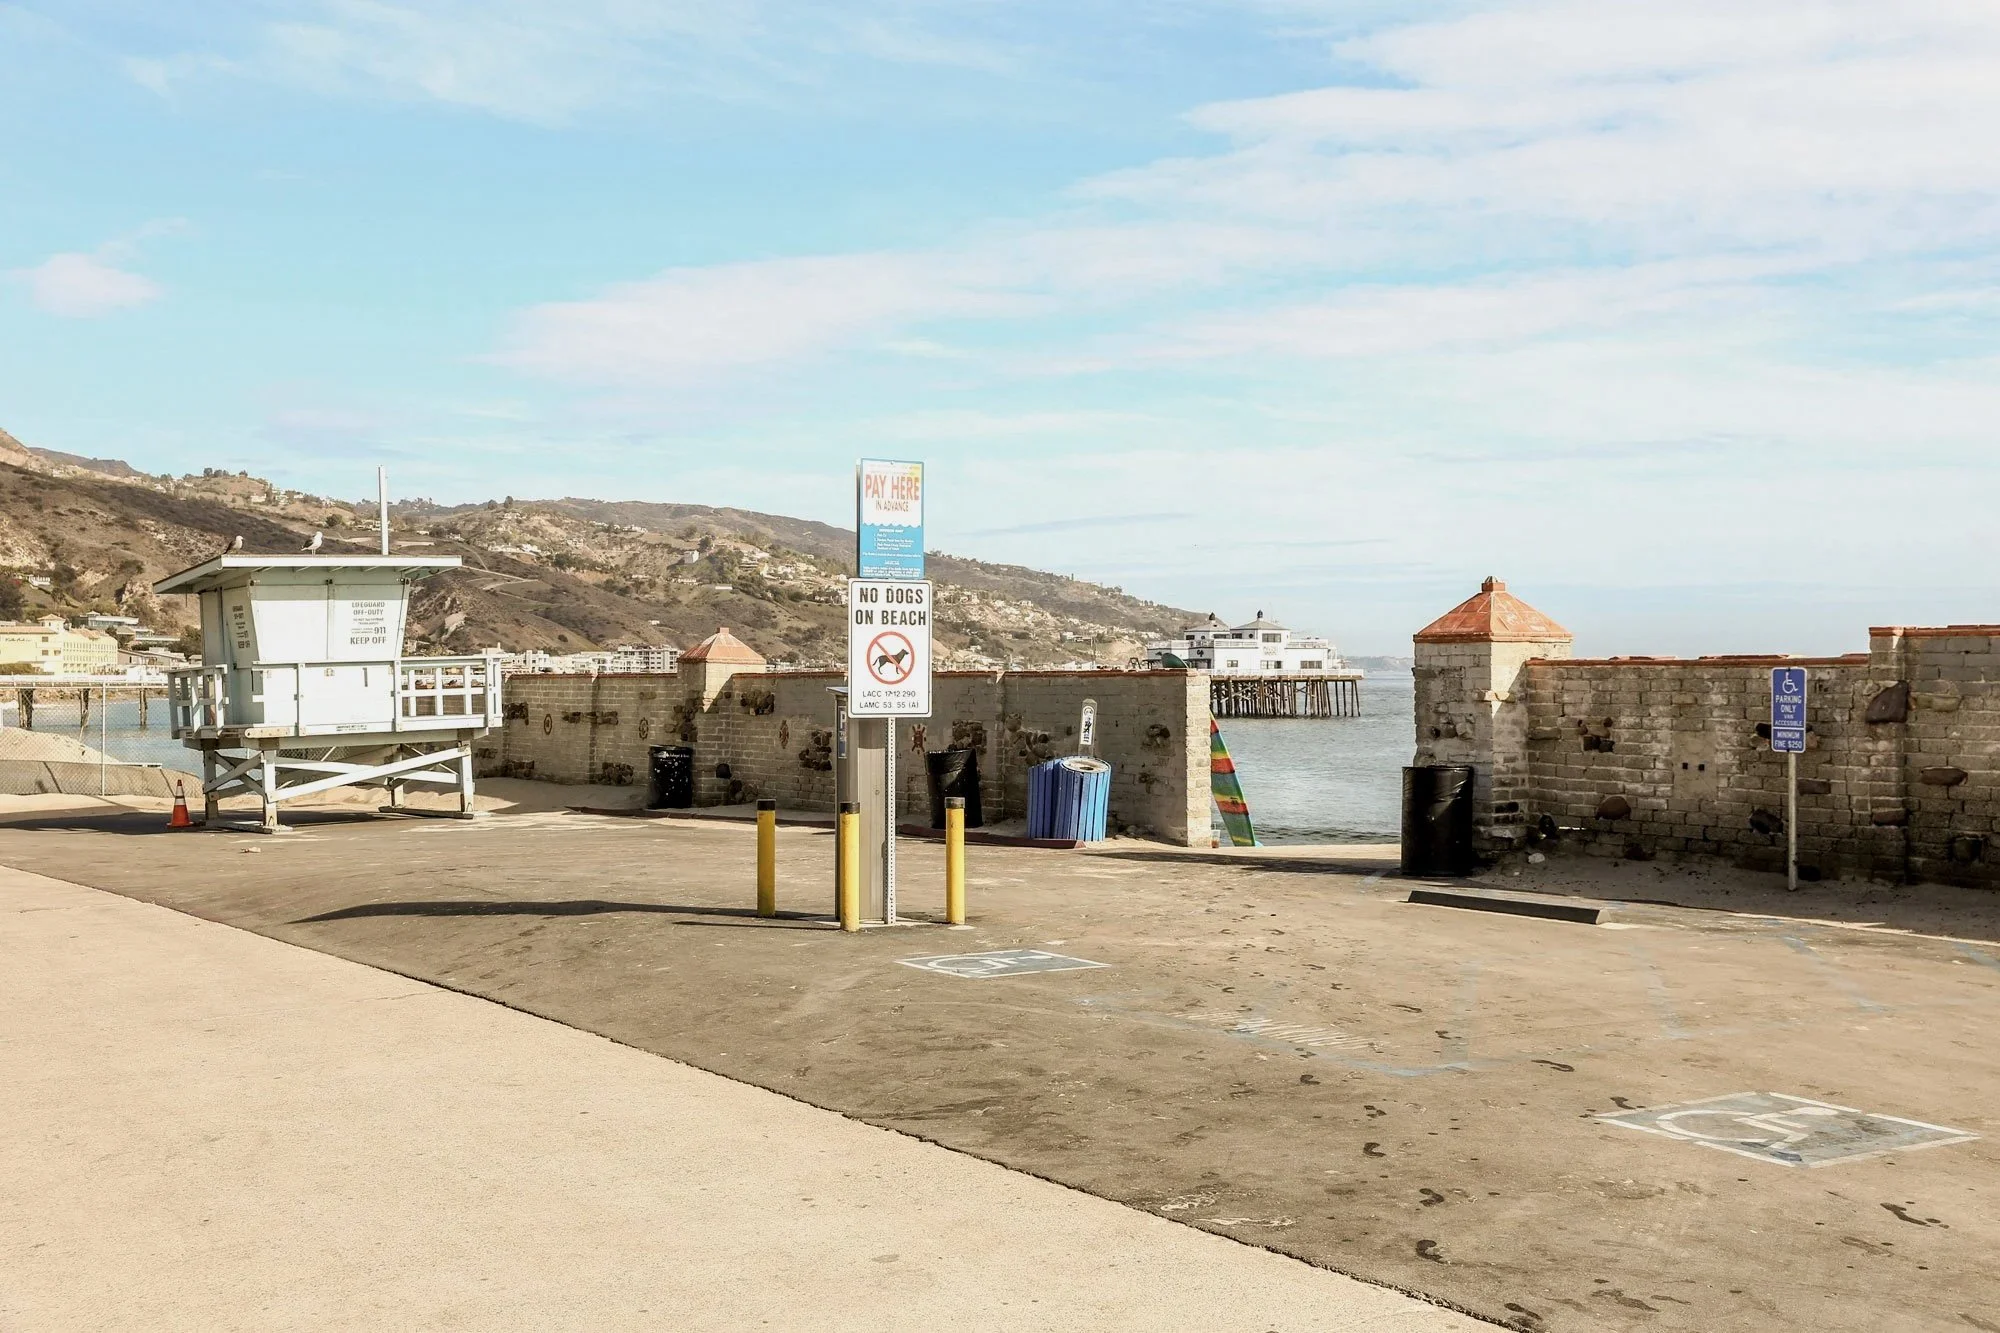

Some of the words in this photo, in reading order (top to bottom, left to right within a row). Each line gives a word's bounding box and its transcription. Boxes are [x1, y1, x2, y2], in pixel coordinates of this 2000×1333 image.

[865, 474, 886, 498] PAY
[891, 476, 920, 500] HERE
[876, 500, 882, 511] IN
[884, 501, 909, 512] ADVANCE
[859, 587, 878, 603] NO
[886, 588, 923, 604] DOGS
[855, 610, 874, 625] ON
[881, 611, 927, 626] BEACH
[350, 637, 370, 645] KEEP
[372, 636, 387, 644] OFF
[862, 690, 882, 698] LACC
[1776, 695, 1802, 704] PARKING
[859, 701, 880, 709] LAMC
[1780, 704, 1796, 713] ONLY
[1777, 731, 1800, 739] MINIMUM
[1774, 740, 1786, 748] FINE
[1788, 741, 1803, 749] $250
